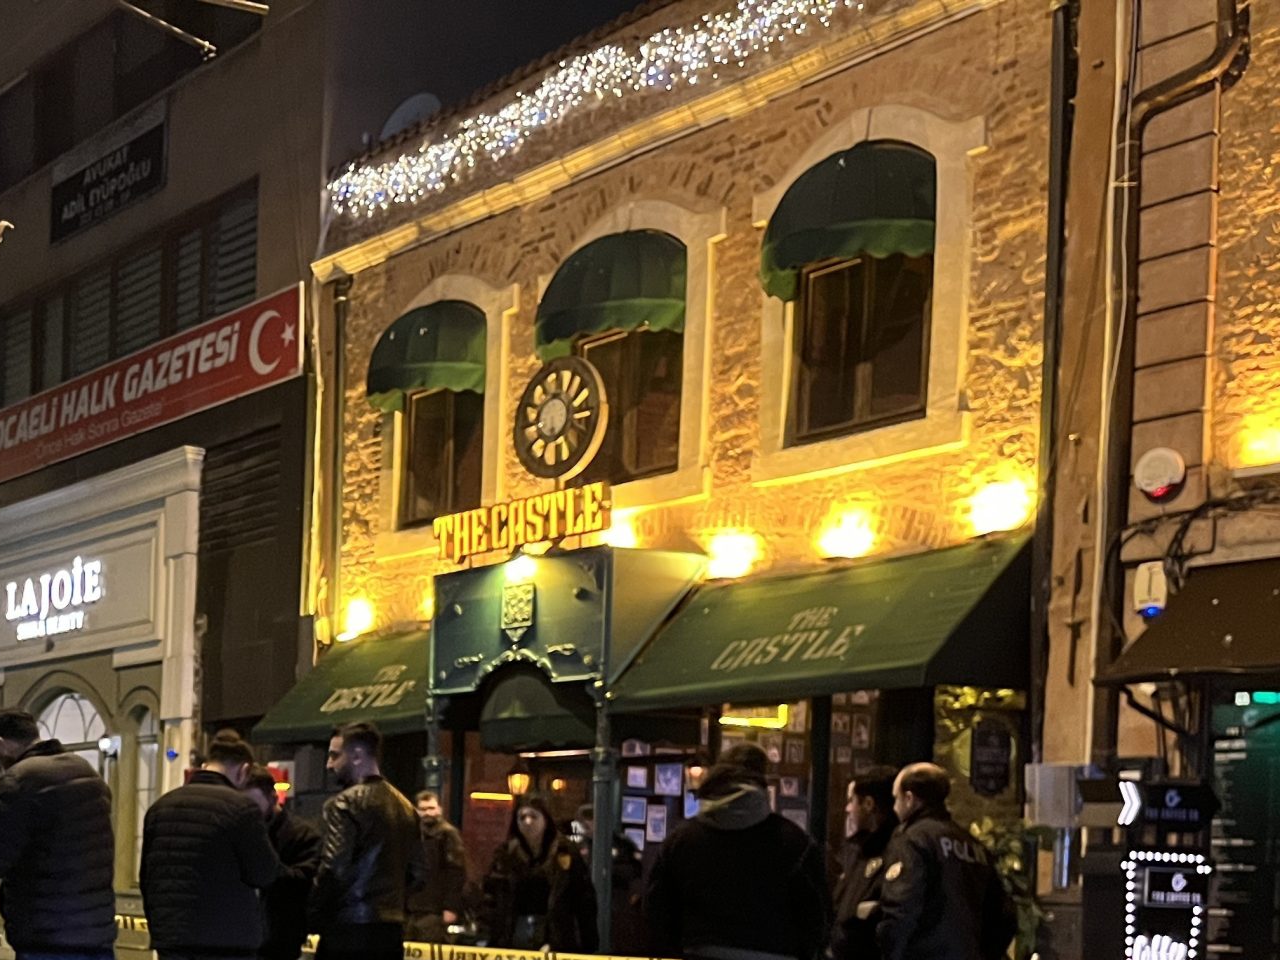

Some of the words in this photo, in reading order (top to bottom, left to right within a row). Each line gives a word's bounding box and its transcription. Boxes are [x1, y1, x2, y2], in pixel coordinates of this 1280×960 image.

[60, 372, 121, 425] HALK
[122, 320, 242, 403] GAZETESİ
[433, 507, 489, 564] THE
[490, 481, 608, 554] CASTLE
[710, 623, 866, 673] CASTLE
[786, 605, 840, 632] THE
